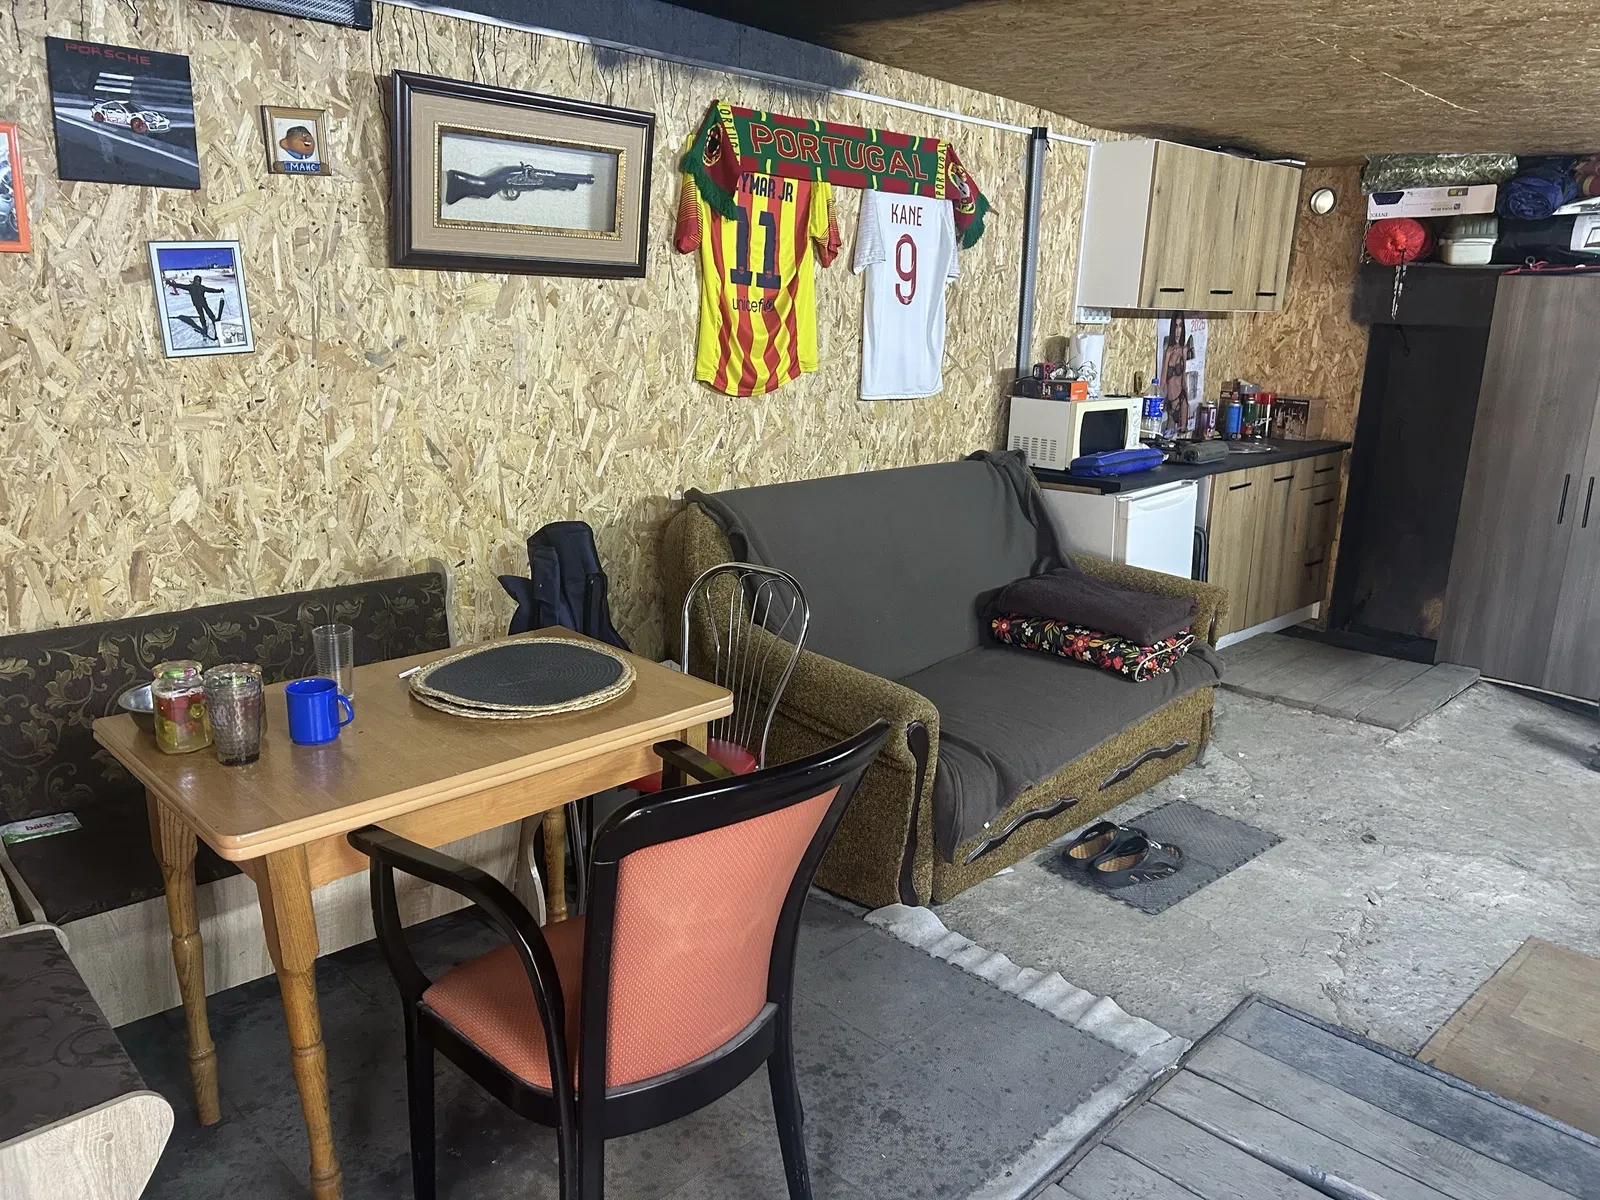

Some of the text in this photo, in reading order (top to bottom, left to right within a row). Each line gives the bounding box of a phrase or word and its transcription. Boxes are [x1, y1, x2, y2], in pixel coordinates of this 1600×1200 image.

[64, 42, 151, 65] PORSCHE
[749, 121, 928, 180] PORTUGAL
[935, 143, 947, 197] PORTUGAL
[778, 181, 794, 203] JR
[891, 203, 923, 226] KANE
[730, 206, 781, 289] 11
[894, 233, 917, 305] 9
[732, 296, 764, 313] unicef
[25, 822, 54, 831] baby
